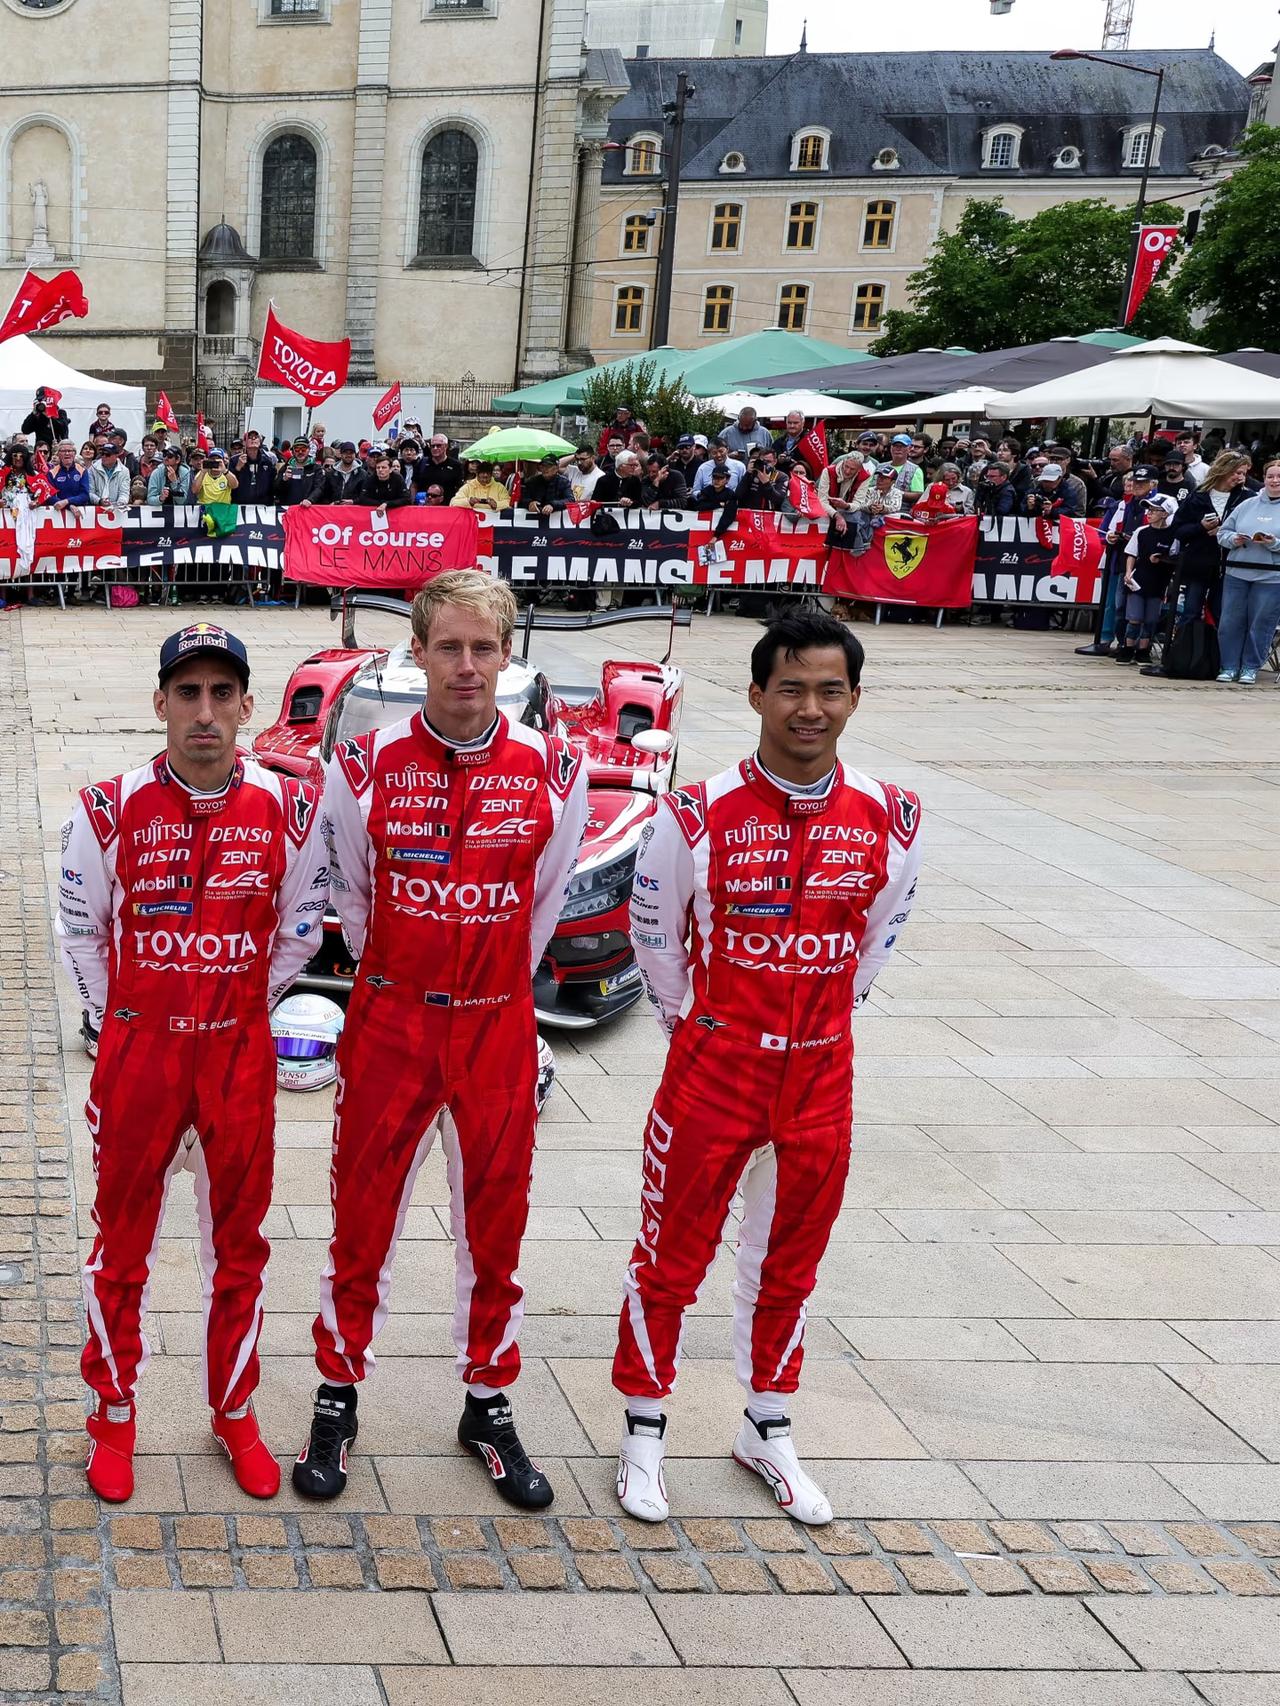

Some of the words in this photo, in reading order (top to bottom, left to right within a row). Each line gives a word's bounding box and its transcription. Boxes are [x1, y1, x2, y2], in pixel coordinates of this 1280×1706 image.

[273, 336, 336, 386] TOYOTA
[312, 524, 353, 546] :Of
[358, 530, 445, 548] course
[320, 546, 350, 569] LE
[363, 549, 443, 573] MANS
[179, 635, 203, 652] Red
[203, 635, 228, 649] Bull
[457, 752, 491, 763] TOYOTA
[385, 762, 449, 792] FUJITSU
[469, 775, 539, 792] DENSO
[192, 799, 228, 810] TOYOTA
[481, 799, 523, 813] ZENT
[793, 800, 828, 811] TOYOTA
[133, 816, 193, 847] FUJITSU
[208, 826, 273, 845] DENSO
[387, 821, 433, 837] Mobil
[725, 815, 790, 846] FUJITSU
[808, 825, 878, 846] DENSO
[220, 850, 263, 866] ZENT
[402, 852, 445, 861] MICHELIN
[821, 850, 866, 865] ZENT
[132, 875, 176, 893] Mobil
[389, 871, 521, 910] TOYOTA
[725, 875, 773, 893] Mobil
[148, 904, 188, 913] MICHELIN
[387, 899, 520, 924] RACING
[742, 906, 786, 914] MICHELIN
[134, 930, 258, 960] TOYOTA
[724, 927, 856, 961] TOYOTA
[132, 959, 256, 974] RACING
[721, 953, 850, 975] RACING
